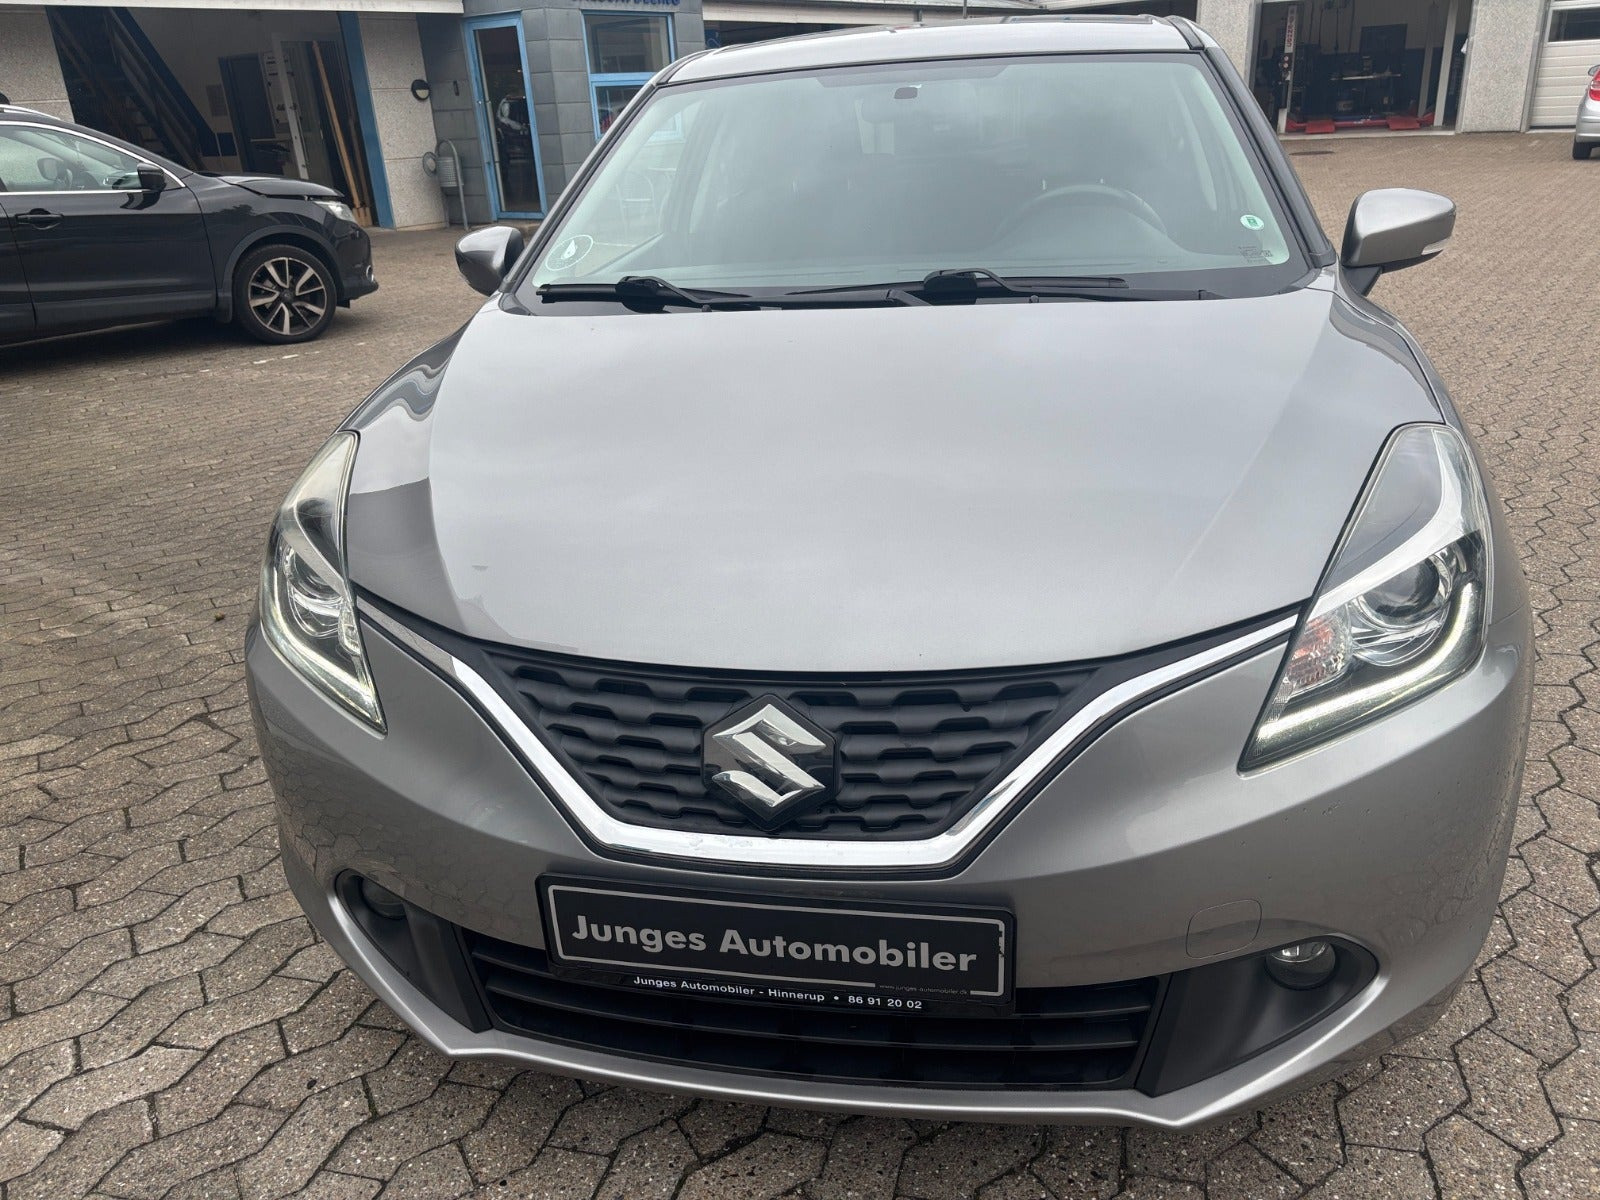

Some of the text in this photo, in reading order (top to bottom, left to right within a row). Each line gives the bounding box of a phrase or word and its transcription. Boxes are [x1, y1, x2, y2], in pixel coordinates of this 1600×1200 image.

[572, 915, 977, 971] Junges Automobiler
[633, 976, 677, 988] Junges
[680, 980, 755, 995] Automobiler
[768, 988, 825, 1001] Hinnerup
[848, 994, 863, 1004] 86
[867, 996, 881, 1005] 91
[887, 998, 902, 1007] 20
[906, 1000, 922, 1009] 02
